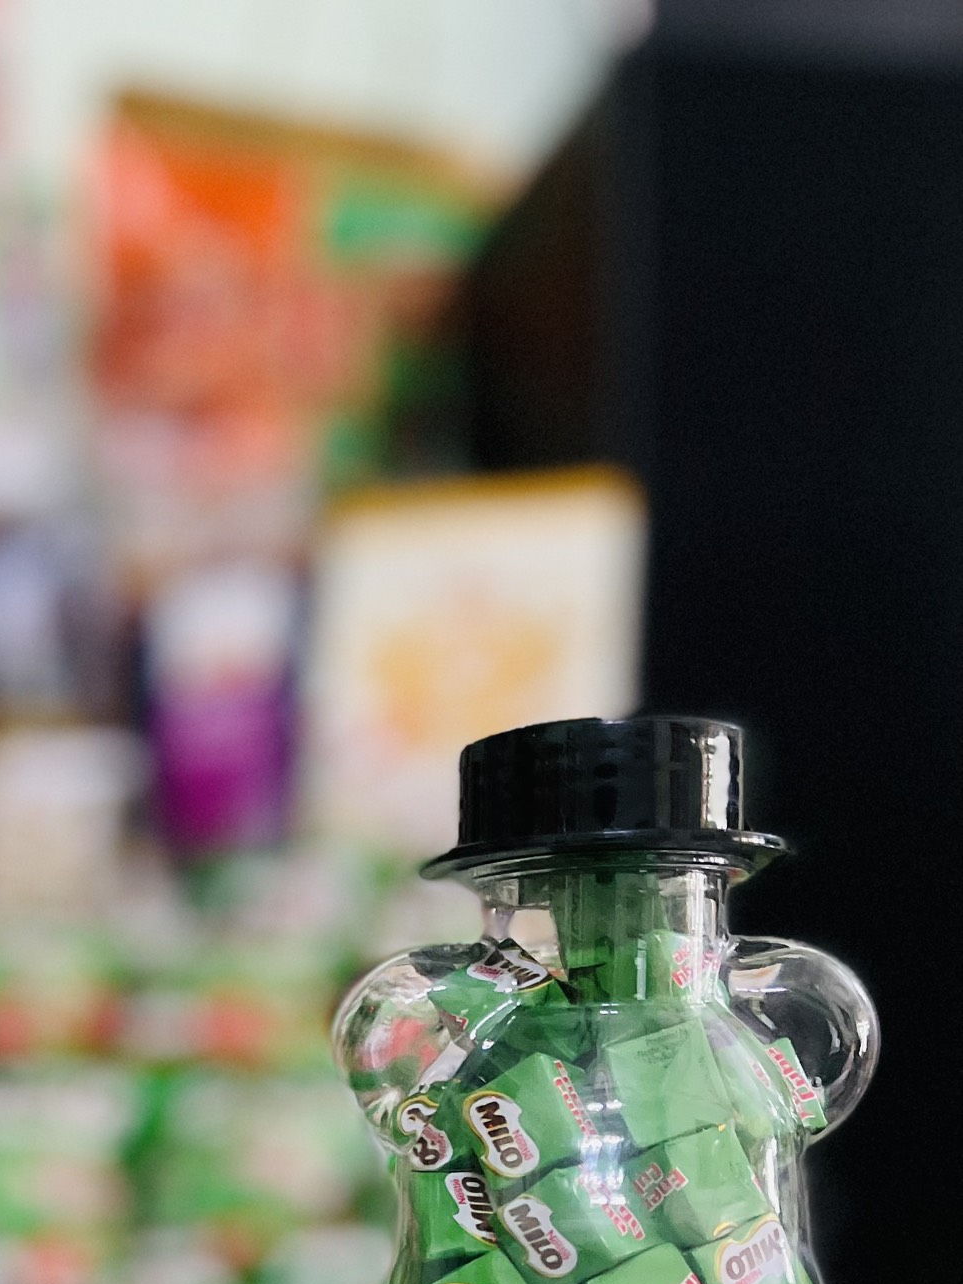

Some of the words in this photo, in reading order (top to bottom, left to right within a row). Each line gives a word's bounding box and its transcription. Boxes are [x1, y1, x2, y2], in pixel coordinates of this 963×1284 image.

[766, 1047, 817, 1100] Cube
[476, 1102, 523, 1168] MILO
[509, 1203, 563, 1270] MILO
[726, 1229, 783, 1280] MILO
